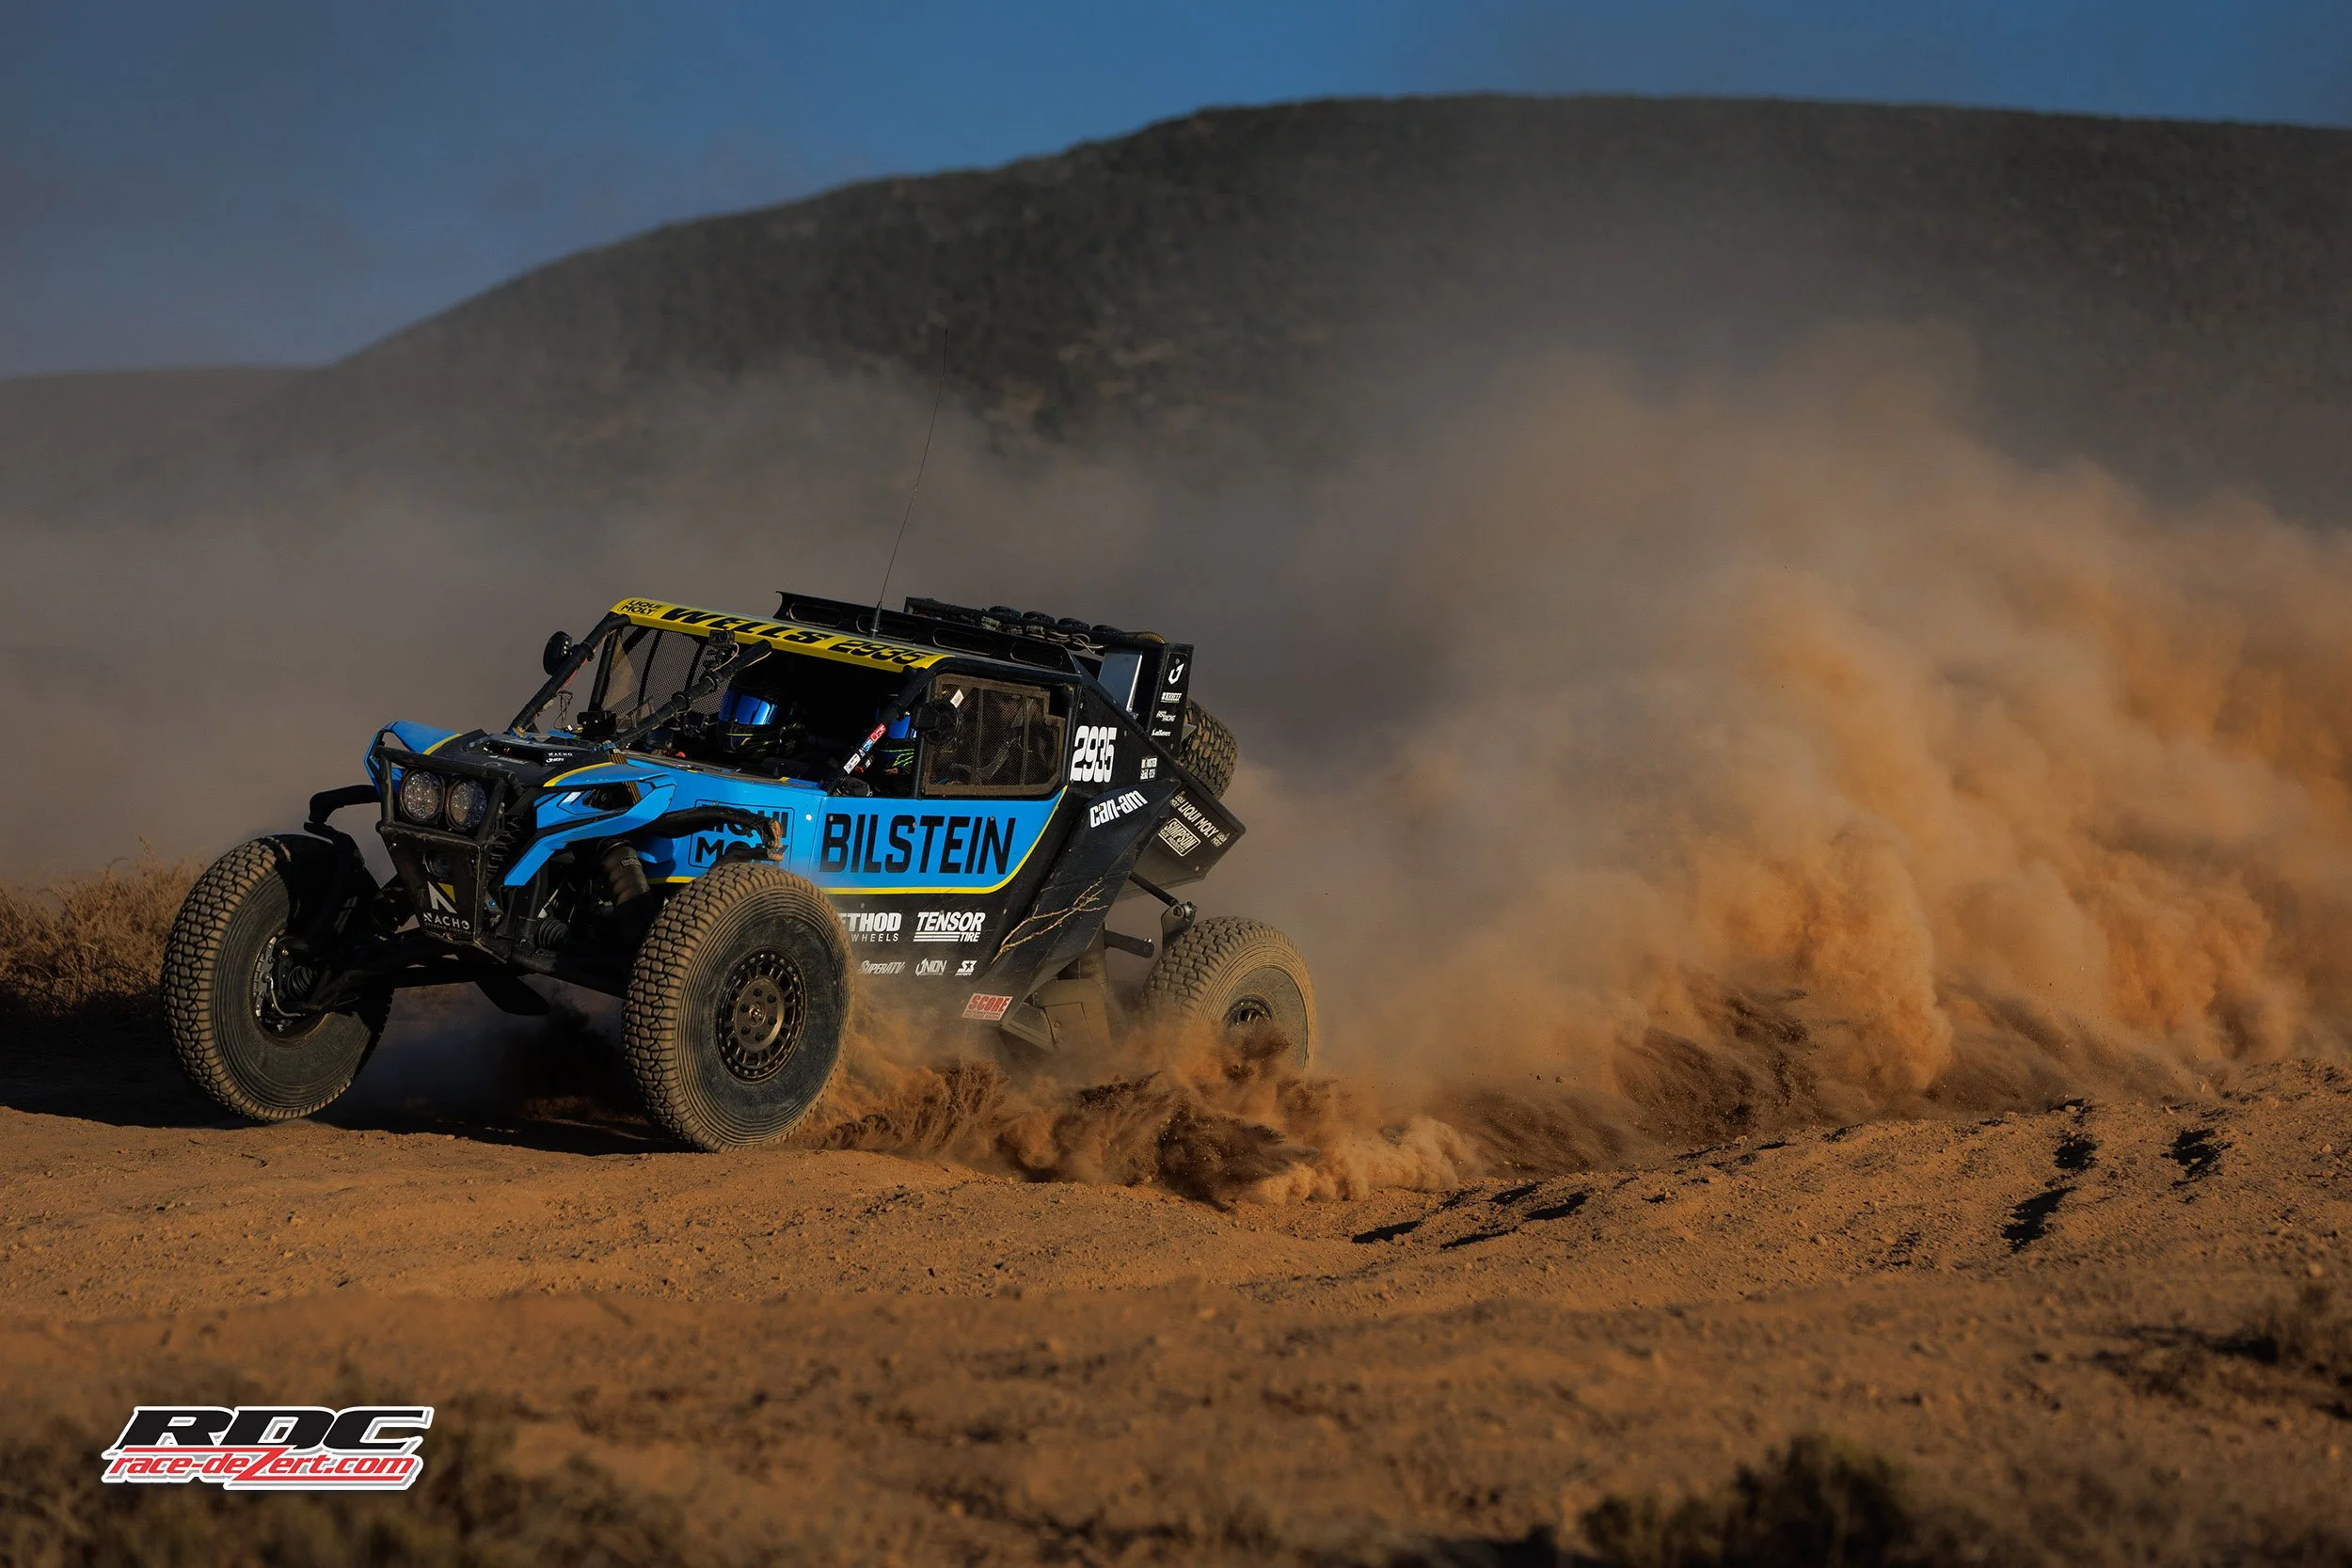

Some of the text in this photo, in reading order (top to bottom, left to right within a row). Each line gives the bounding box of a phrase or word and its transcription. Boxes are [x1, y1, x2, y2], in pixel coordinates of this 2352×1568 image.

[620, 604, 657, 615] MOLY
[660, 607, 939, 665] WELLS 2935
[1070, 725, 1118, 783] 2935
[1089, 790, 1149, 828] can-am
[1177, 801, 1219, 838] LIQUI MOLY
[818, 813, 1017, 875] BILSTEIN
[1164, 820, 1198, 849] SIMPSON
[422, 911, 470, 930] NACHO
[836, 912, 902, 932] THOD
[915, 911, 986, 932] TENSOR
[851, 933, 899, 942] WHEELS
[960, 931, 981, 942] TIRE
[968, 995, 1010, 1013] SCORE
